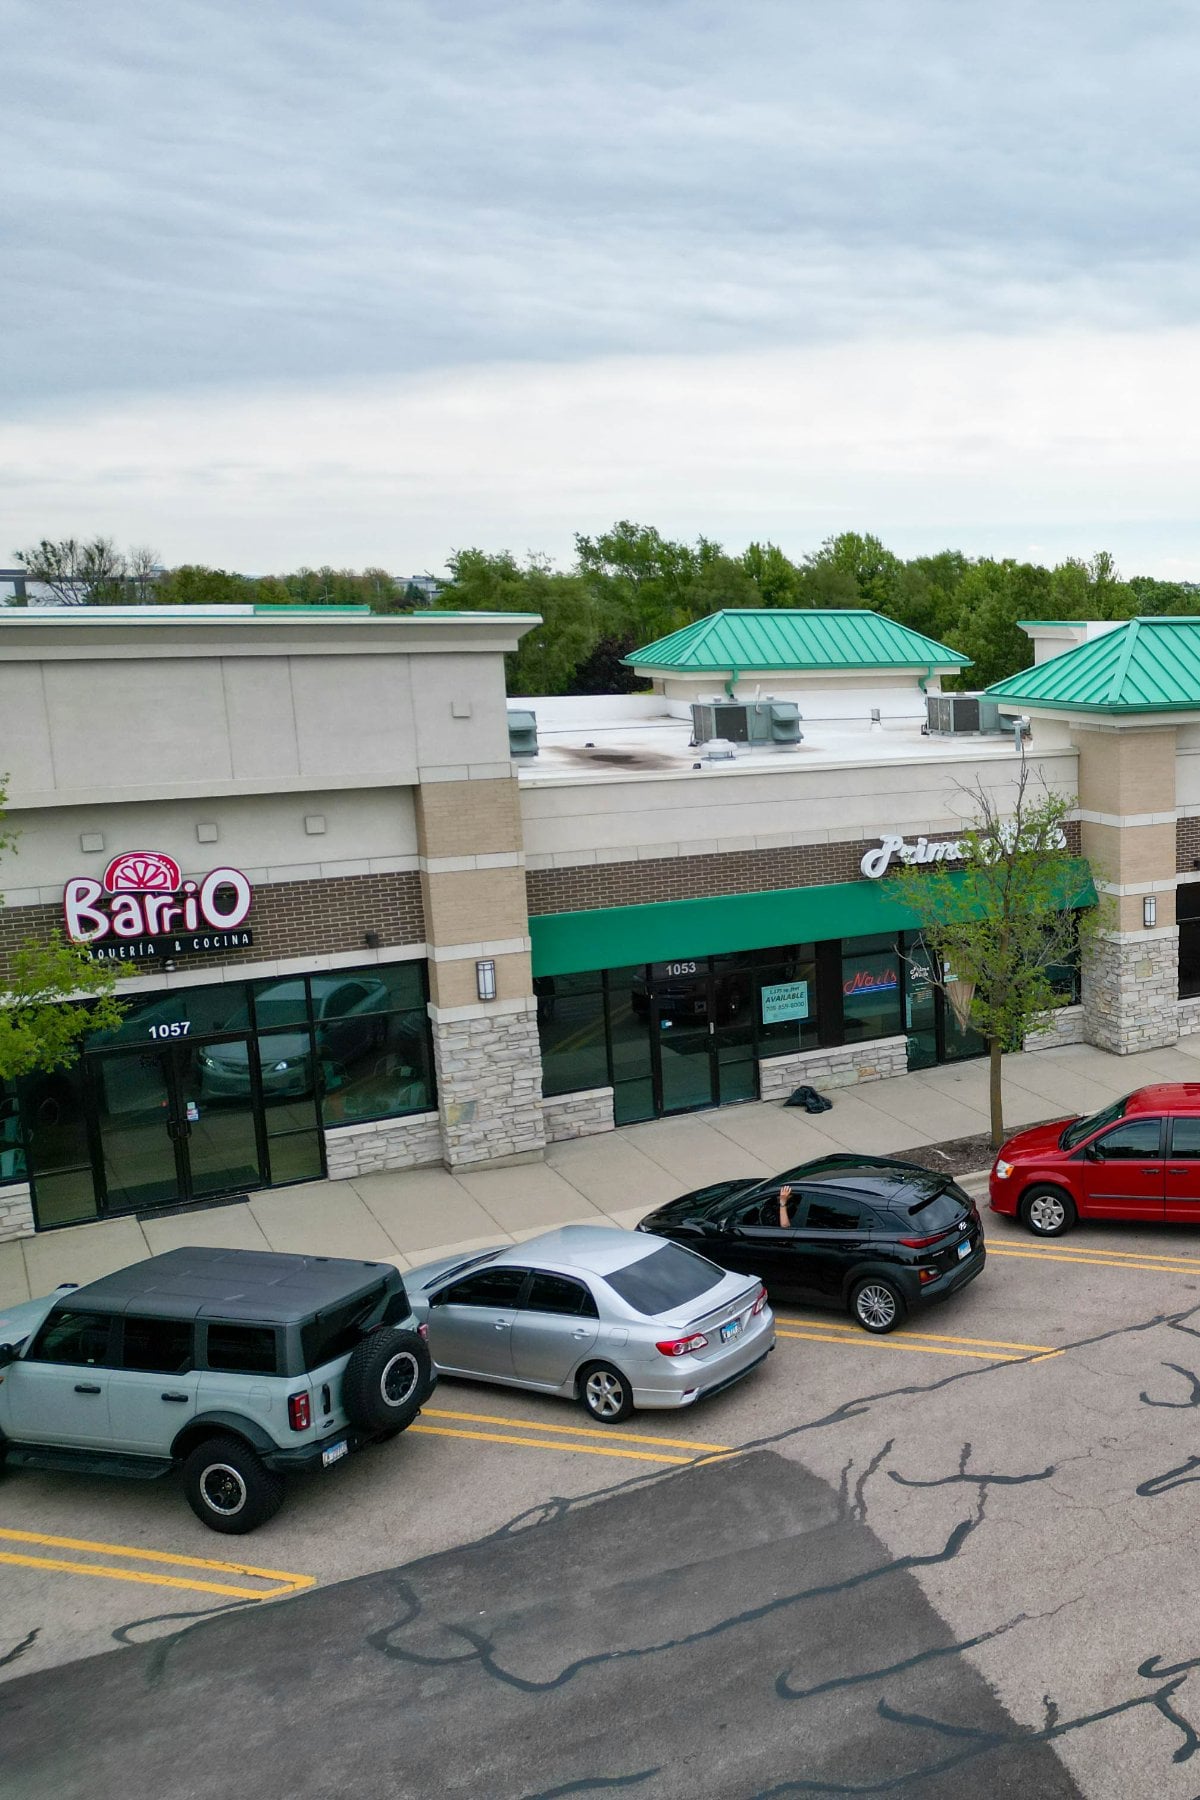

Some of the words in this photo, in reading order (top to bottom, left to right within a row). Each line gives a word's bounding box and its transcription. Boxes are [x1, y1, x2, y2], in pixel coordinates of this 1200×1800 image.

[193, 933, 250, 950] COCINA
[666, 962, 697, 976] 1053
[843, 970, 897, 995] Nails
[765, 991, 805, 1004] AVAILABLE
[149, 1021, 191, 1039] 1057
